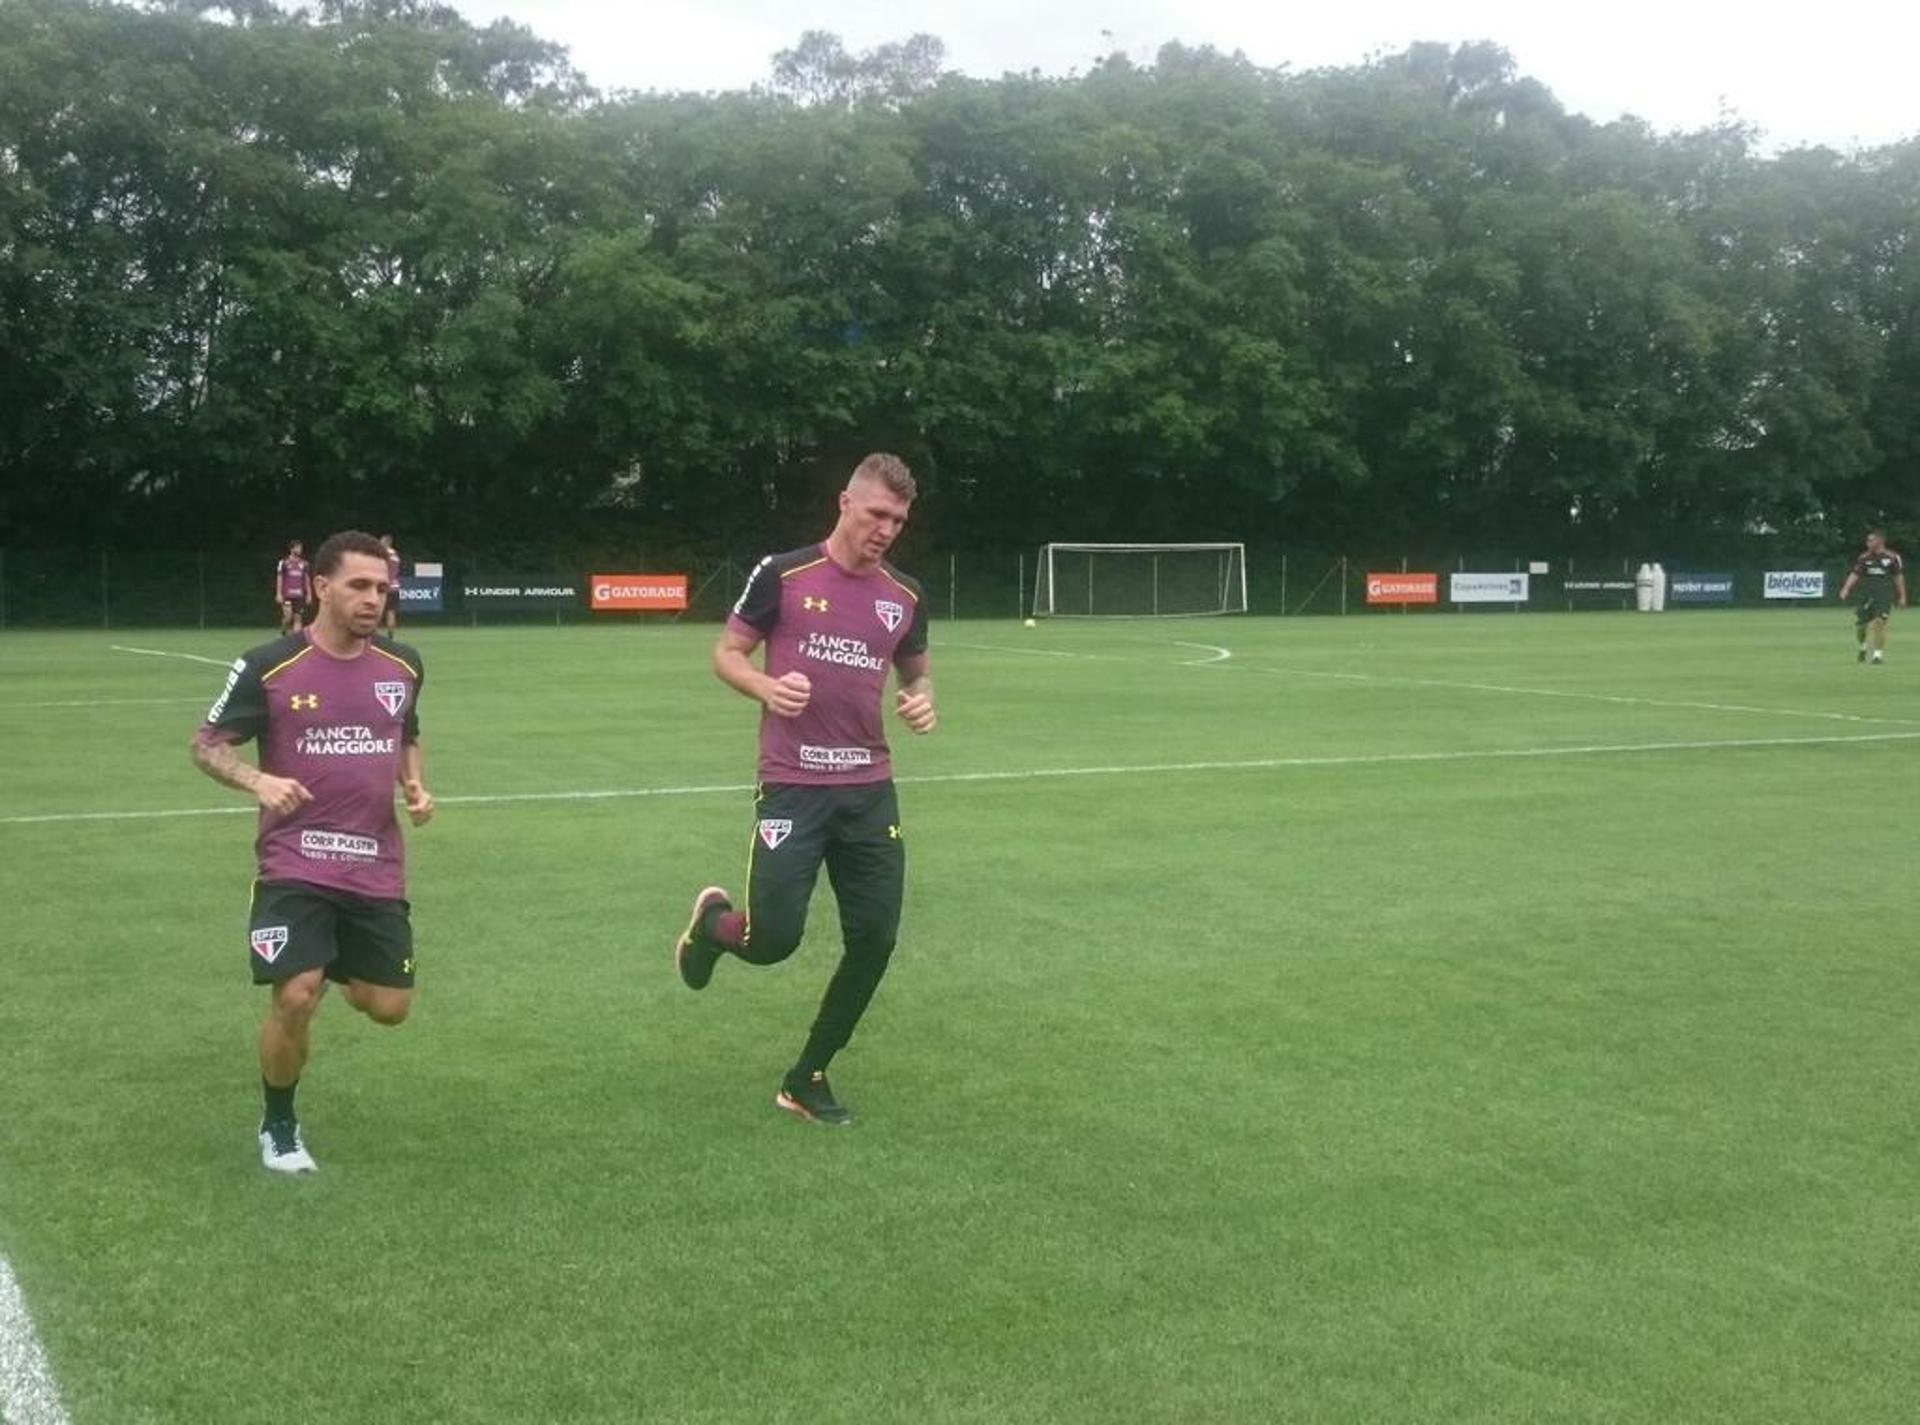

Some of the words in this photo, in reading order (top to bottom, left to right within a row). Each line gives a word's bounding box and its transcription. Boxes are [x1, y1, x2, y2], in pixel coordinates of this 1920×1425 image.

[480, 587, 520, 596] UNDER
[524, 587, 575, 596] ARMOUR
[611, 586, 686, 598] GATORADE
[808, 633, 868, 655] SANCTA
[806, 645, 885, 671] MAGGIORE
[305, 726, 373, 740] SANCTA
[305, 738, 395, 755] MAGGIORE
